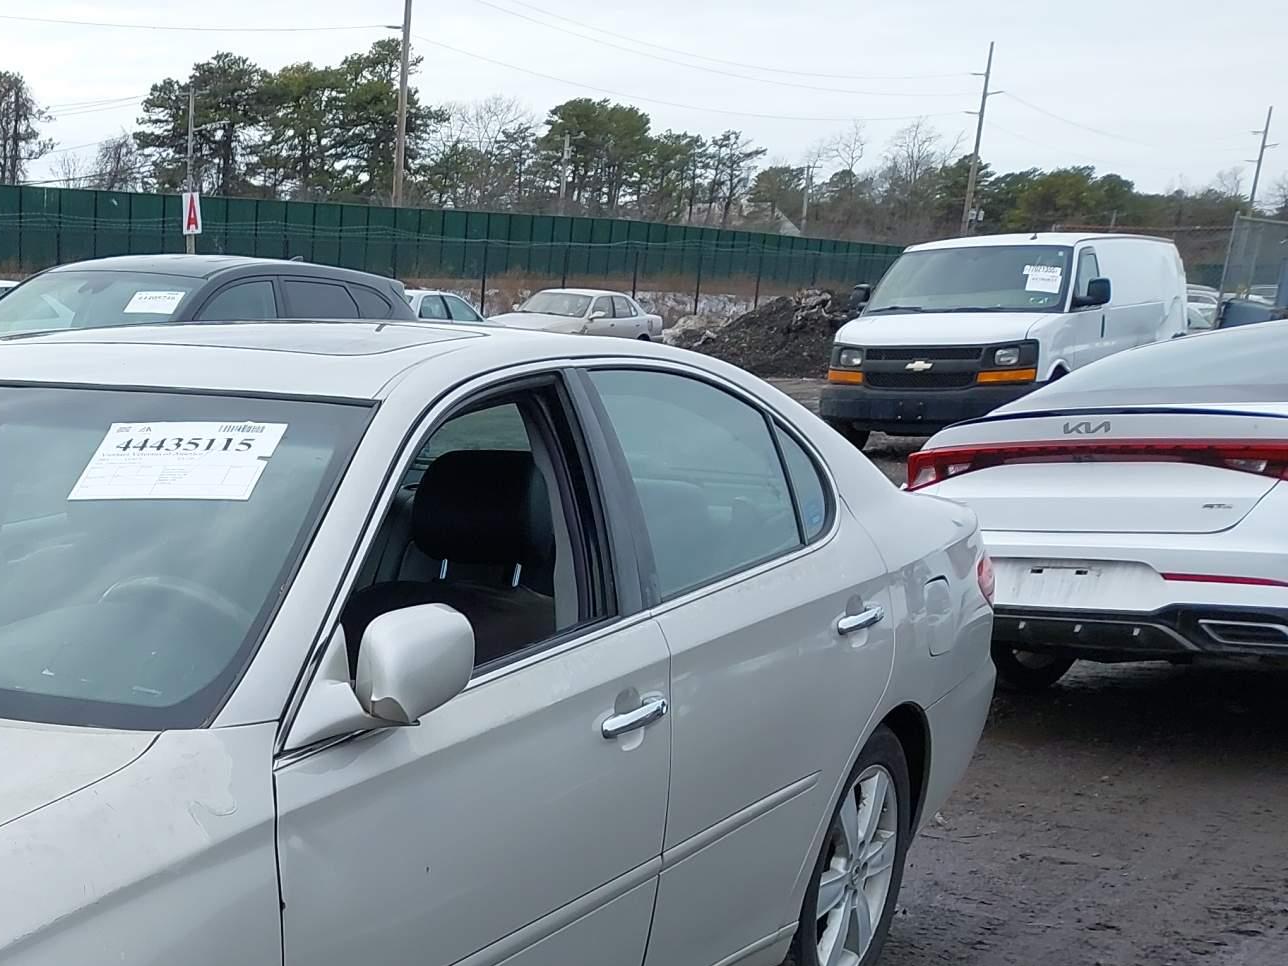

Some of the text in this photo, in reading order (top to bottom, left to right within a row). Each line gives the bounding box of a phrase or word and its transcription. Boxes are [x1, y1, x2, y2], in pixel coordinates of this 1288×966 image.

[187, 193, 199, 230] A
[1063, 420, 1111, 434] KIA
[115, 437, 256, 452] 44435115
